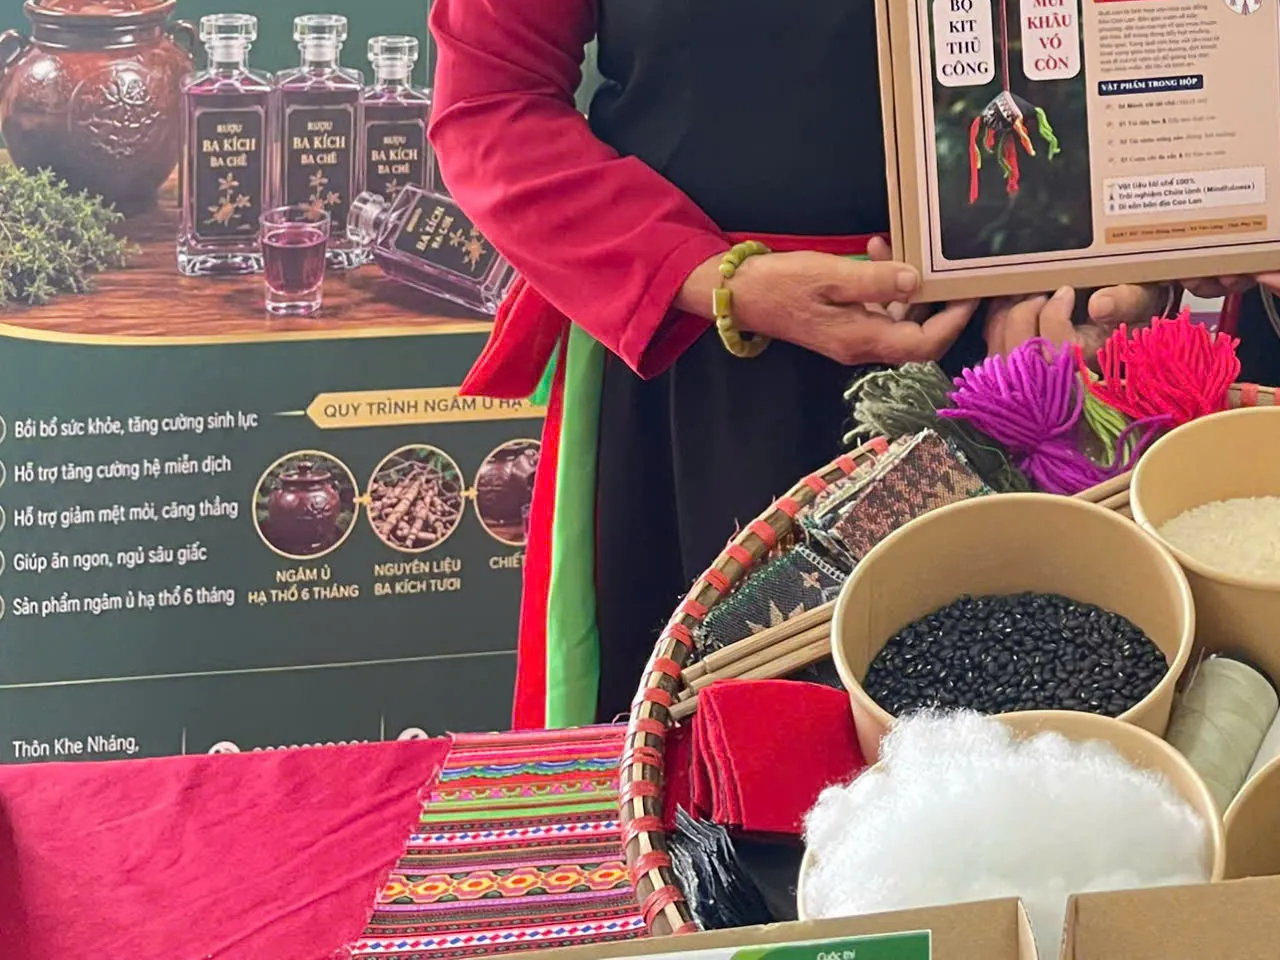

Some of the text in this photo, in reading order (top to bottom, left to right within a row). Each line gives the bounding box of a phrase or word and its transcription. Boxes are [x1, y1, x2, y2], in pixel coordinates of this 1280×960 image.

[949, 20, 977, 34] KIT
[1027, 12, 1072, 30] KHÂU
[1039, 33, 1063, 50] VÓ
[942, 60, 989, 77] CÔNG
[1034, 54, 1069, 72] CÒN
[1147, 79, 1178, 88] TRONG
[202, 136, 256, 153] BA KÍCH
[292, 133, 346, 150] BA KÍCH
[324, 397, 476, 418] QUY TRÌNH NGÂM
[15, 410, 259, 438] Bồi bổ sức khỏe, tăng cường sinh lực
[14, 453, 232, 484] Hỗ trợ tăng cường hệ miễn dịch
[14, 495, 239, 529] Hỗ trợ giảm mệt mỏi, căng thẳng
[13, 541, 208, 574] Giúp ăn ngon, ngủ sâu giấc
[374, 557, 462, 578] NGUYÊN LIỆU
[276, 565, 332, 582] NGÂM Ủ
[248, 592, 267, 607] HẠ
[301, 588, 310, 601] 6
[313, 583, 360, 600] THÁNG
[374, 577, 461, 597] BA KÍCH TƯƠI
[13, 596, 39, 617] Sản
[41, 591, 81, 618] phẩm
[83, 593, 123, 616] ngâm
[138, 589, 156, 611] hạ
[159, 585, 181, 607] thổ
[184, 588, 194, 605] 6
[197, 587, 236, 607] tháng
[12, 734, 140, 758] Thôn Khe Nháng,
